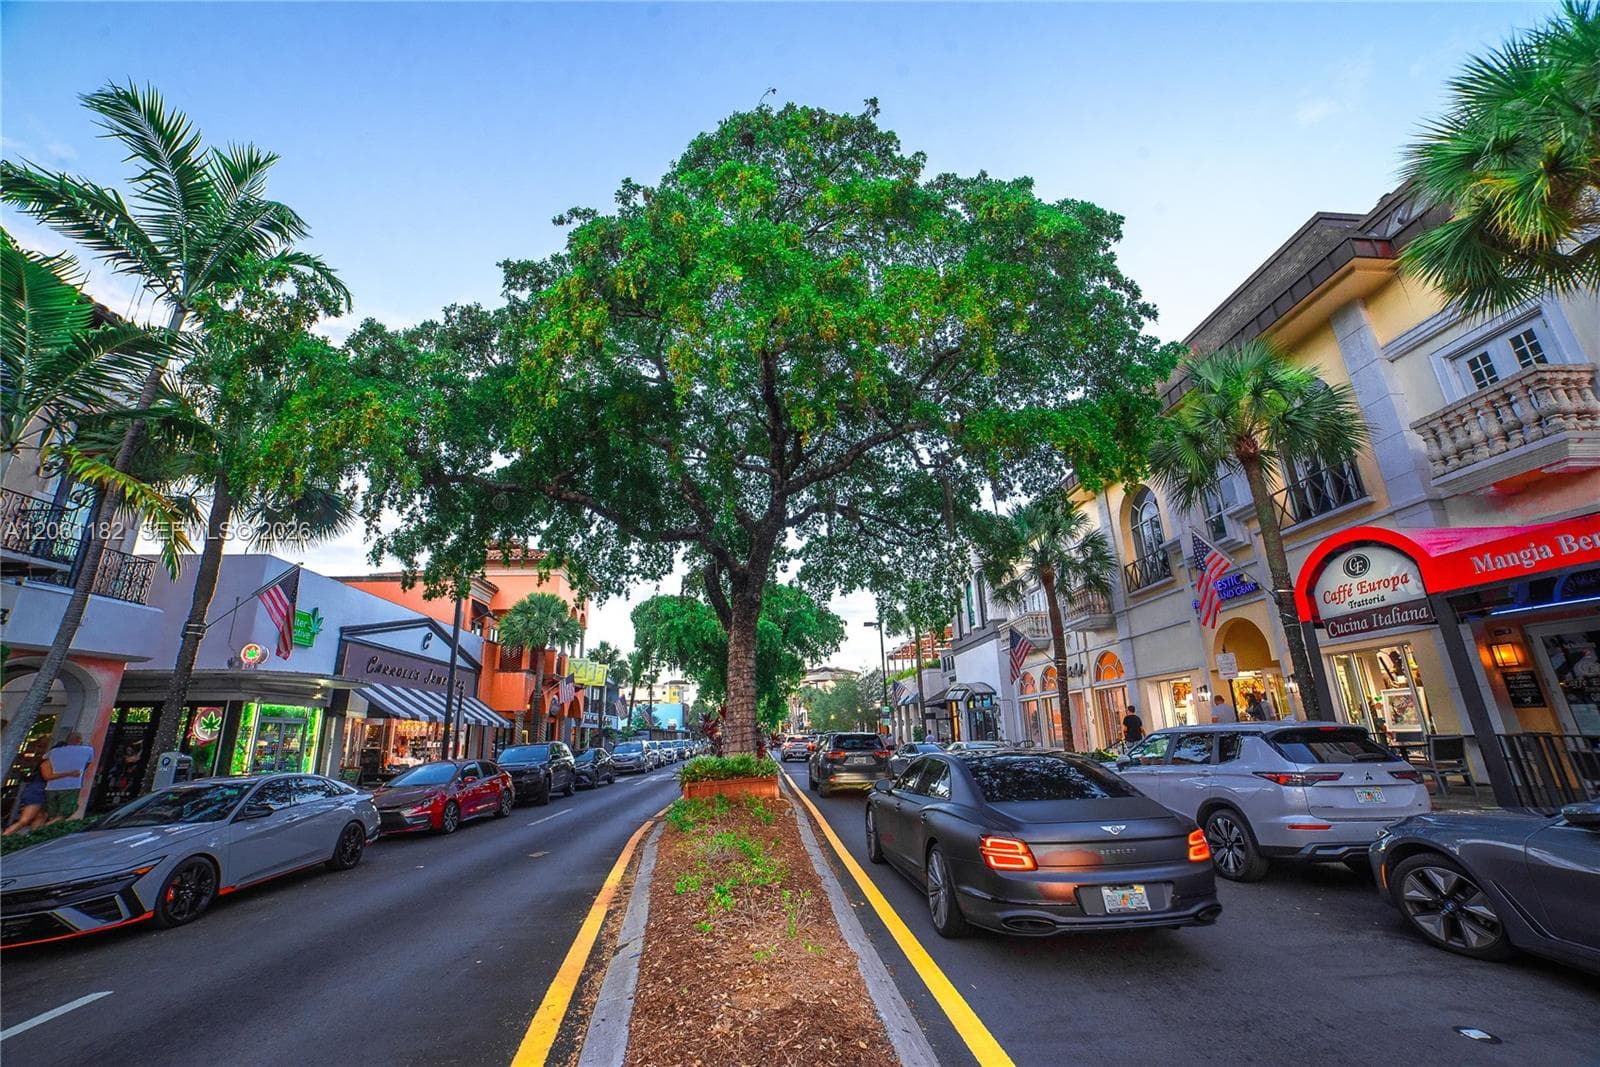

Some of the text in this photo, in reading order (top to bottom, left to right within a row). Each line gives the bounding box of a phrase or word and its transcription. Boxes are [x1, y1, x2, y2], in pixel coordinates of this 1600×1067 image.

[1470, 542, 1554, 575] Mangia
[1216, 573, 1241, 591] ESTIC
[1322, 572, 1410, 605] Caffé Europa
[1347, 594, 1386, 609] Trattoria
[1327, 606, 1429, 637] Cucina Italiana
